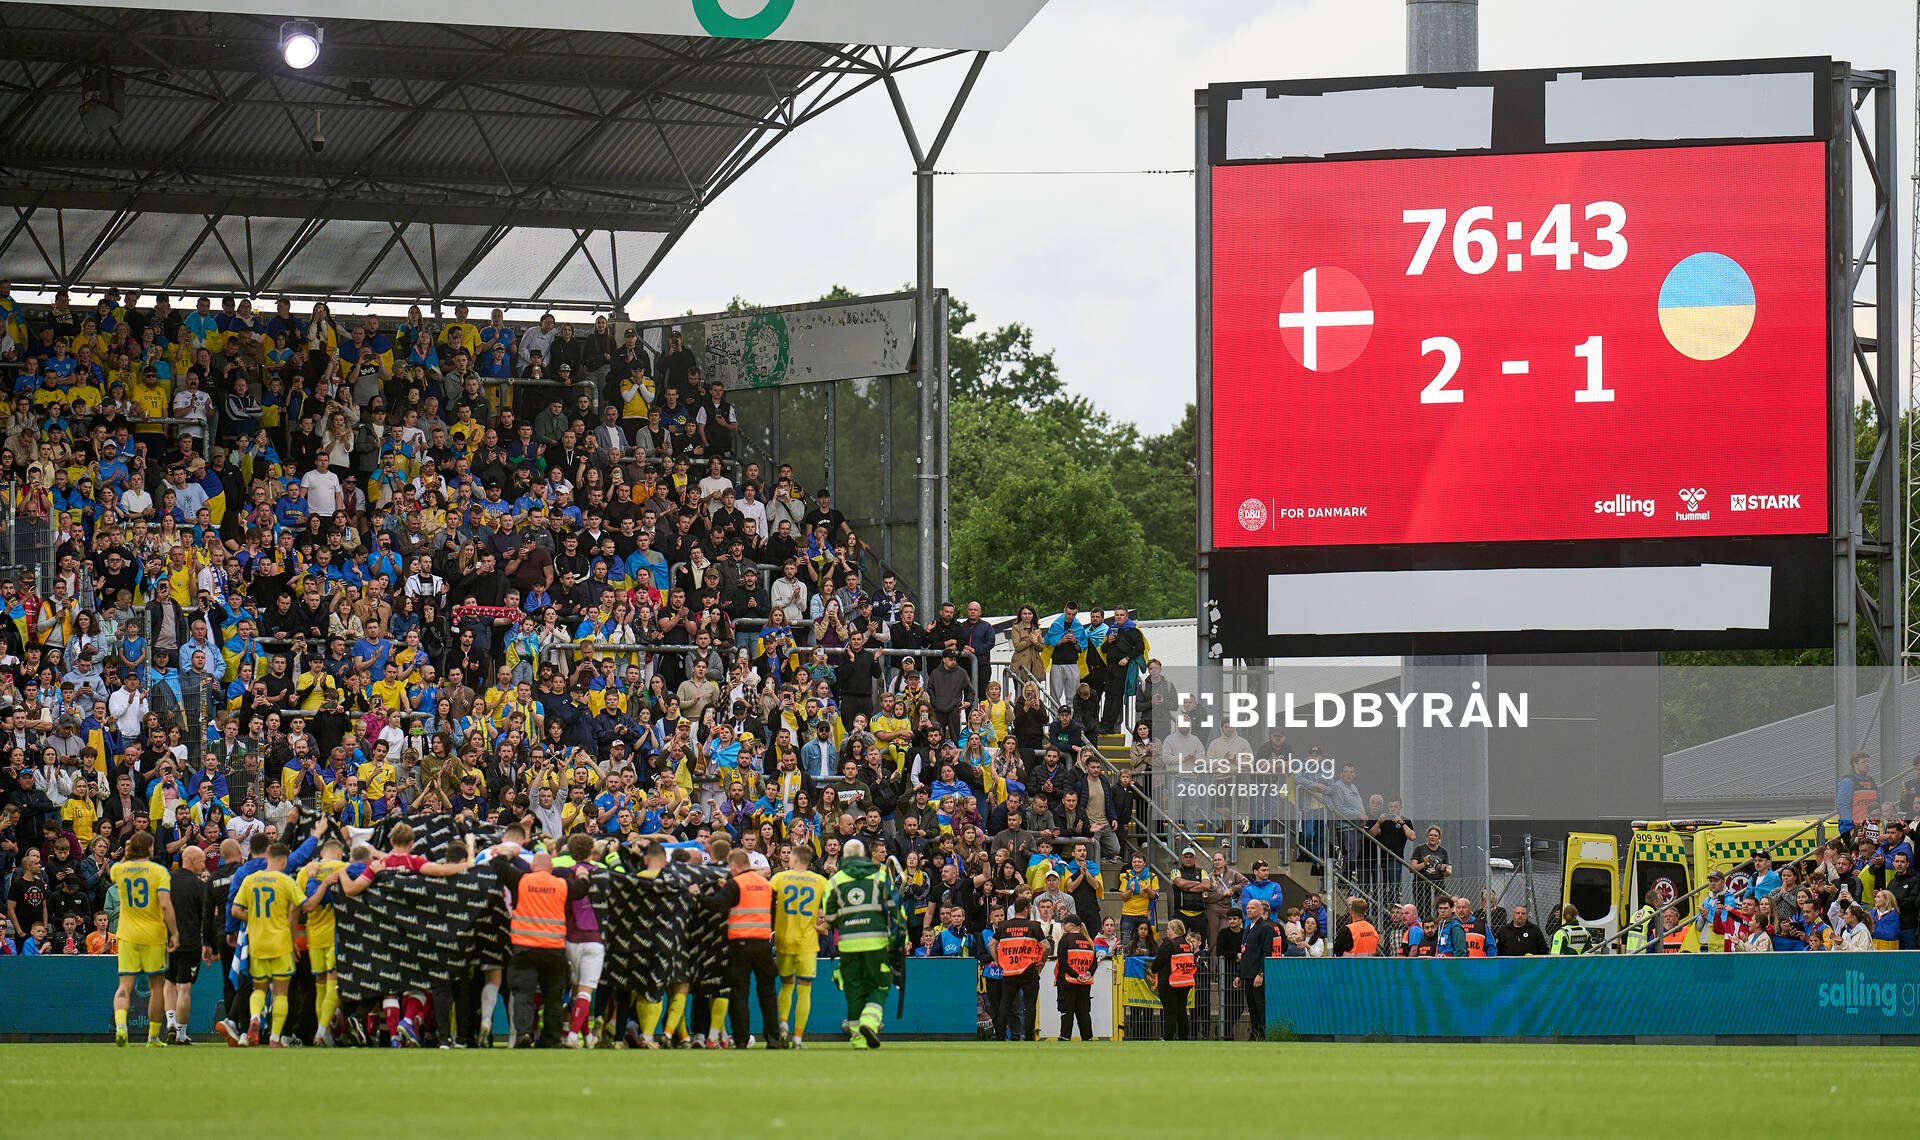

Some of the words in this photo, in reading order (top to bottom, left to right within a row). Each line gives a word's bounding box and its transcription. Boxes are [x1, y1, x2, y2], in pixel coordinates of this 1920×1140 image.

[1402, 200, 1629, 276] 76:43
[1419, 335, 1464, 404] 2
[1574, 335, 1615, 402] 1
[1280, 508, 1304, 519] FOR
[1308, 506, 1368, 518] DANMARK
[1594, 493, 1655, 517] salling
[1747, 494, 1801, 510] STARK
[1675, 510, 1710, 521] hummel
[1636, 833, 1653, 843] 909
[1655, 834, 1669, 844] 911
[123, 877, 149, 908] 13
[252, 886, 276, 918] 17
[527, 885, 557, 895] SECURITY
[783, 885, 815, 917] 22
[1002, 945, 1032, 956] STEWARD
[1819, 969, 1897, 1017] salling
